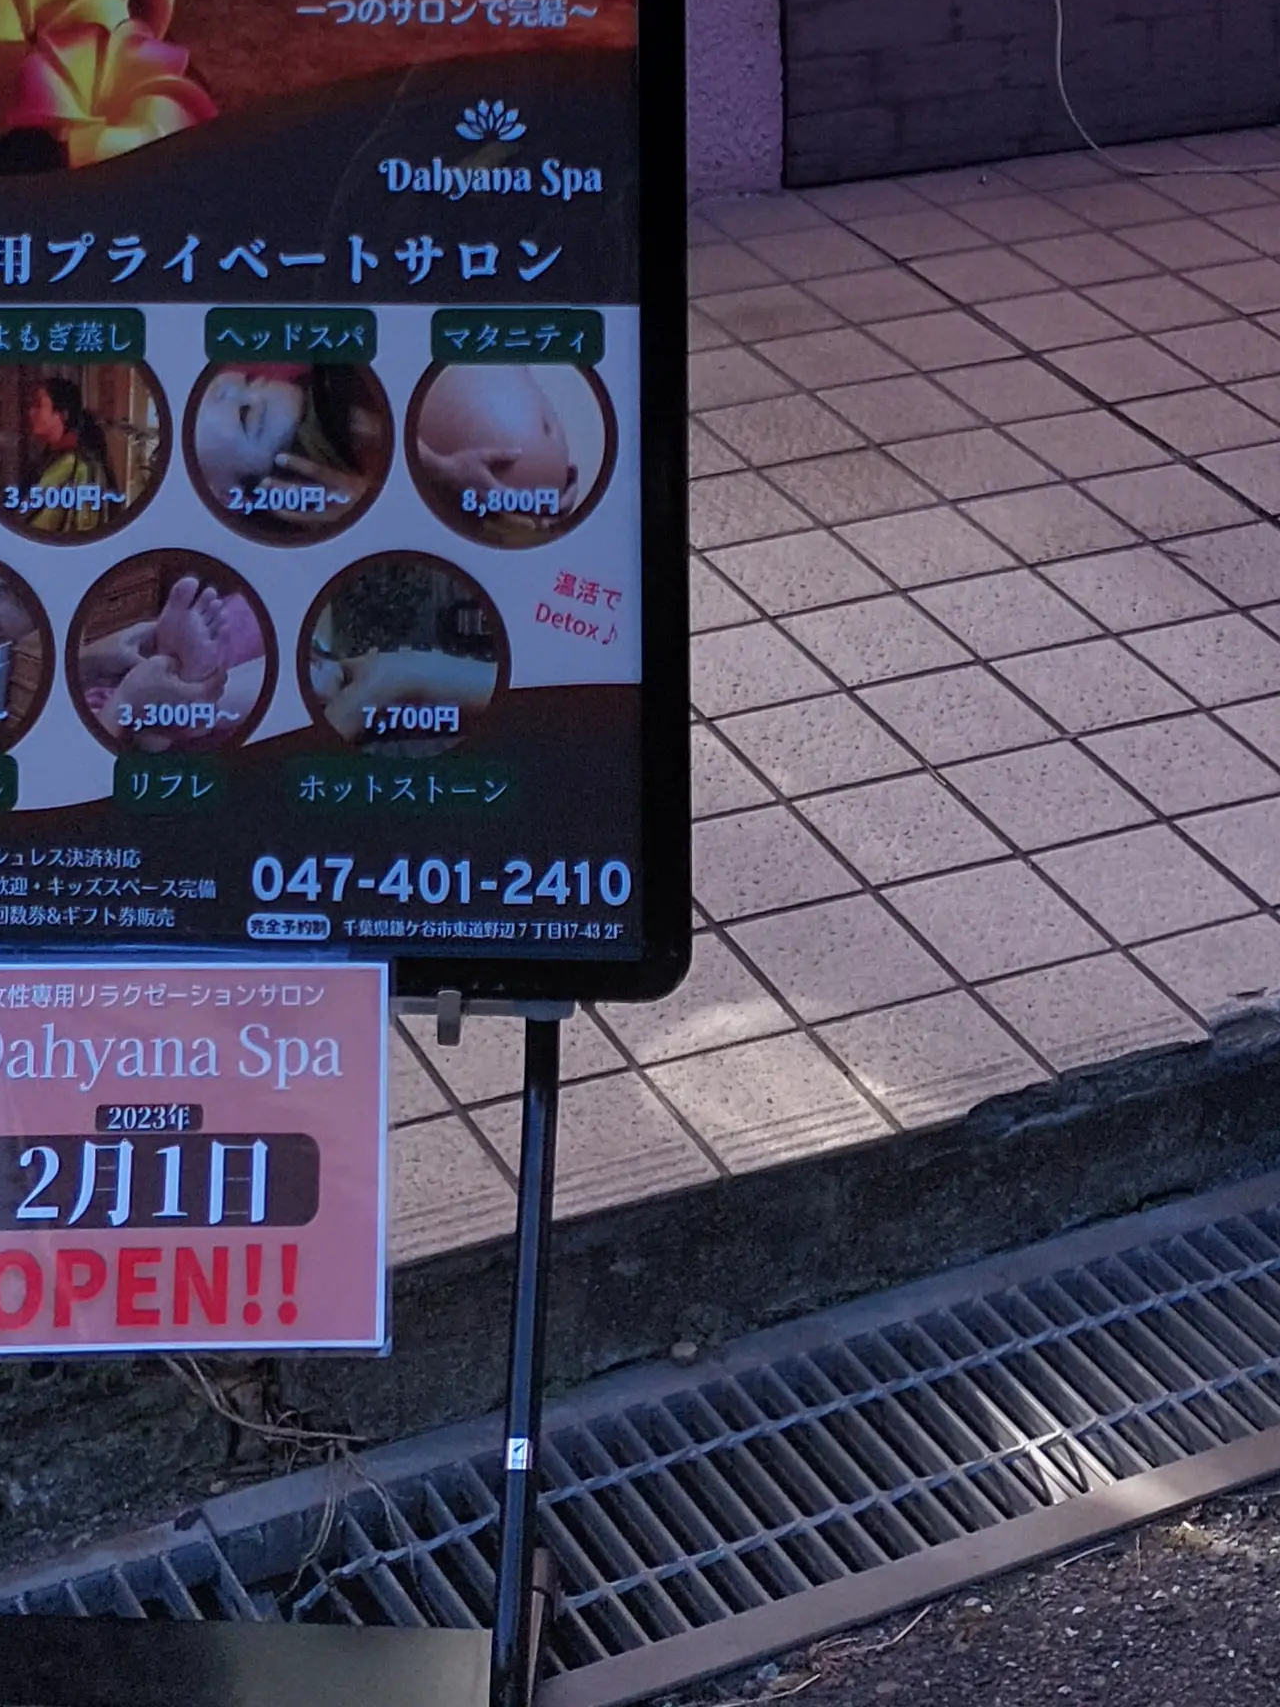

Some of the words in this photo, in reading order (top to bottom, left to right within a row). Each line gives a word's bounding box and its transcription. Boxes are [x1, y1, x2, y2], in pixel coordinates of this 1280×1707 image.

[379, 158, 532, 202] Dahyana
[539, 157, 602, 200] Spa
[217, 323, 365, 351] ヘッドスパ
[444, 324, 586, 354] マタニティ
[3, 485, 127, 513] 3,500円〜
[228, 486, 351, 515] 2,200円〜
[461, 487, 560, 516] 8,800円
[552, 569, 622, 611] 温活で
[117, 701, 241, 732] 3,300円〜
[361, 703, 460, 734] 7,700円
[129, 772, 215, 801] リフレ
[299, 775, 508, 804] ホットストーン
[251, 855, 632, 906] 047-401-2410
[250, 918, 327, 937] 完全予約制
[238, 1023, 343, 1090] Spa
[107, 1103, 191, 1132] 2023年
[16, 1137, 269, 1227] 2月1日
